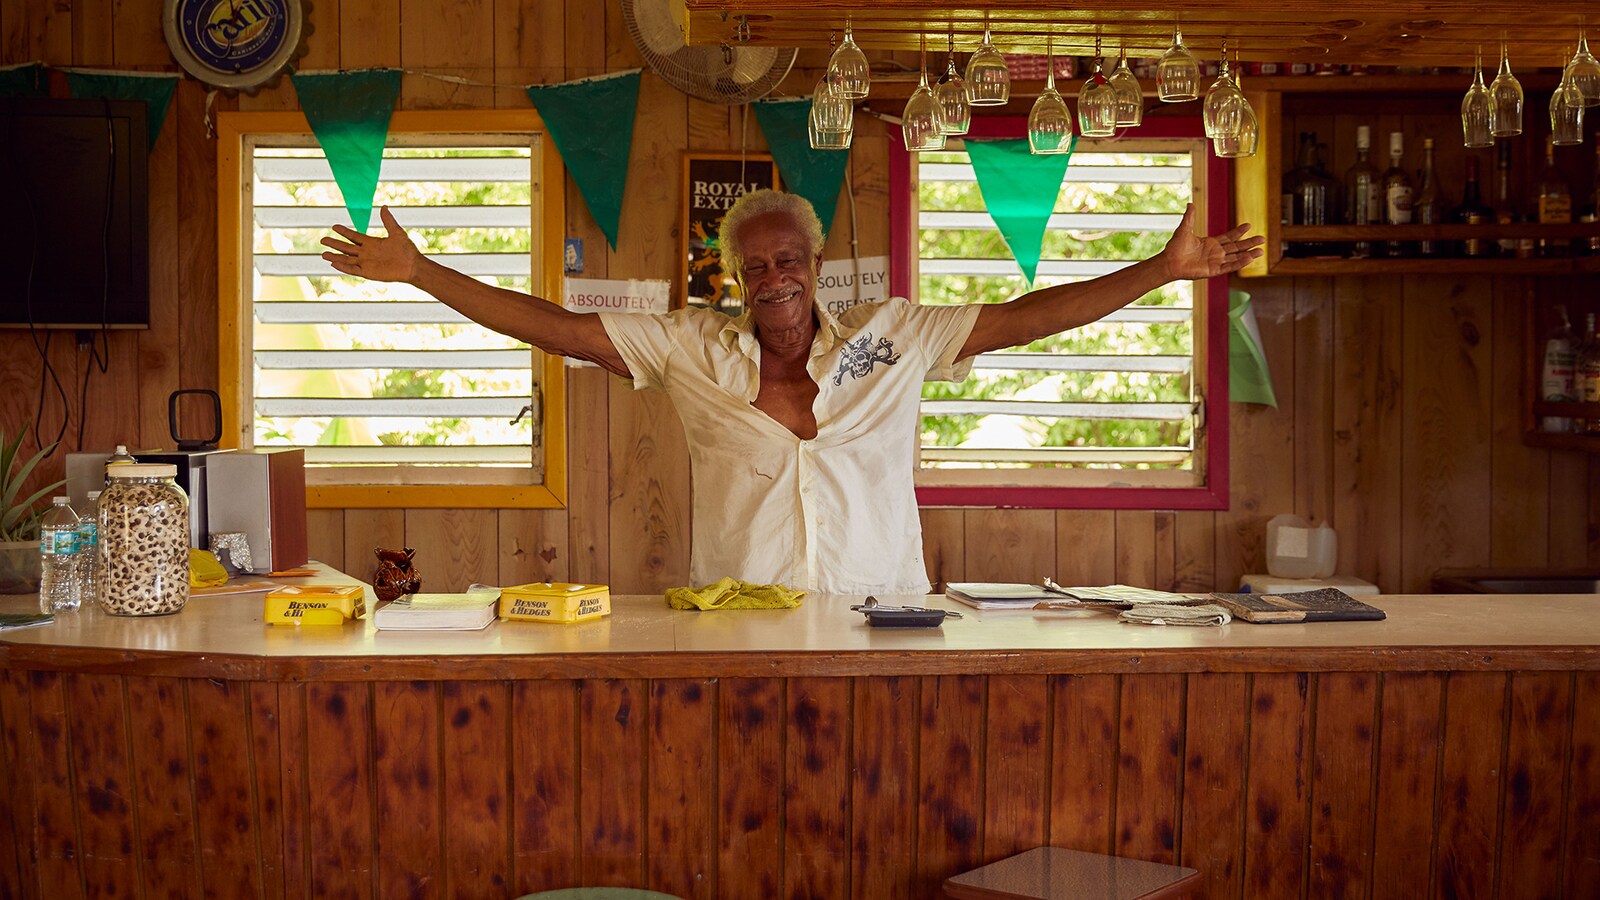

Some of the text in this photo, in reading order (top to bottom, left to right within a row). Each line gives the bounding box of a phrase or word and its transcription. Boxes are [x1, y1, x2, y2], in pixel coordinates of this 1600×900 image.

[693, 180, 760, 197] ROYAL
[693, 194, 741, 210] EXT
[566, 293, 656, 310] ABSOLUTELY
[289, 601, 328, 609] BENSON
[514, 599, 548, 608] BENSON
[516, 607, 552, 616] HEDGES
